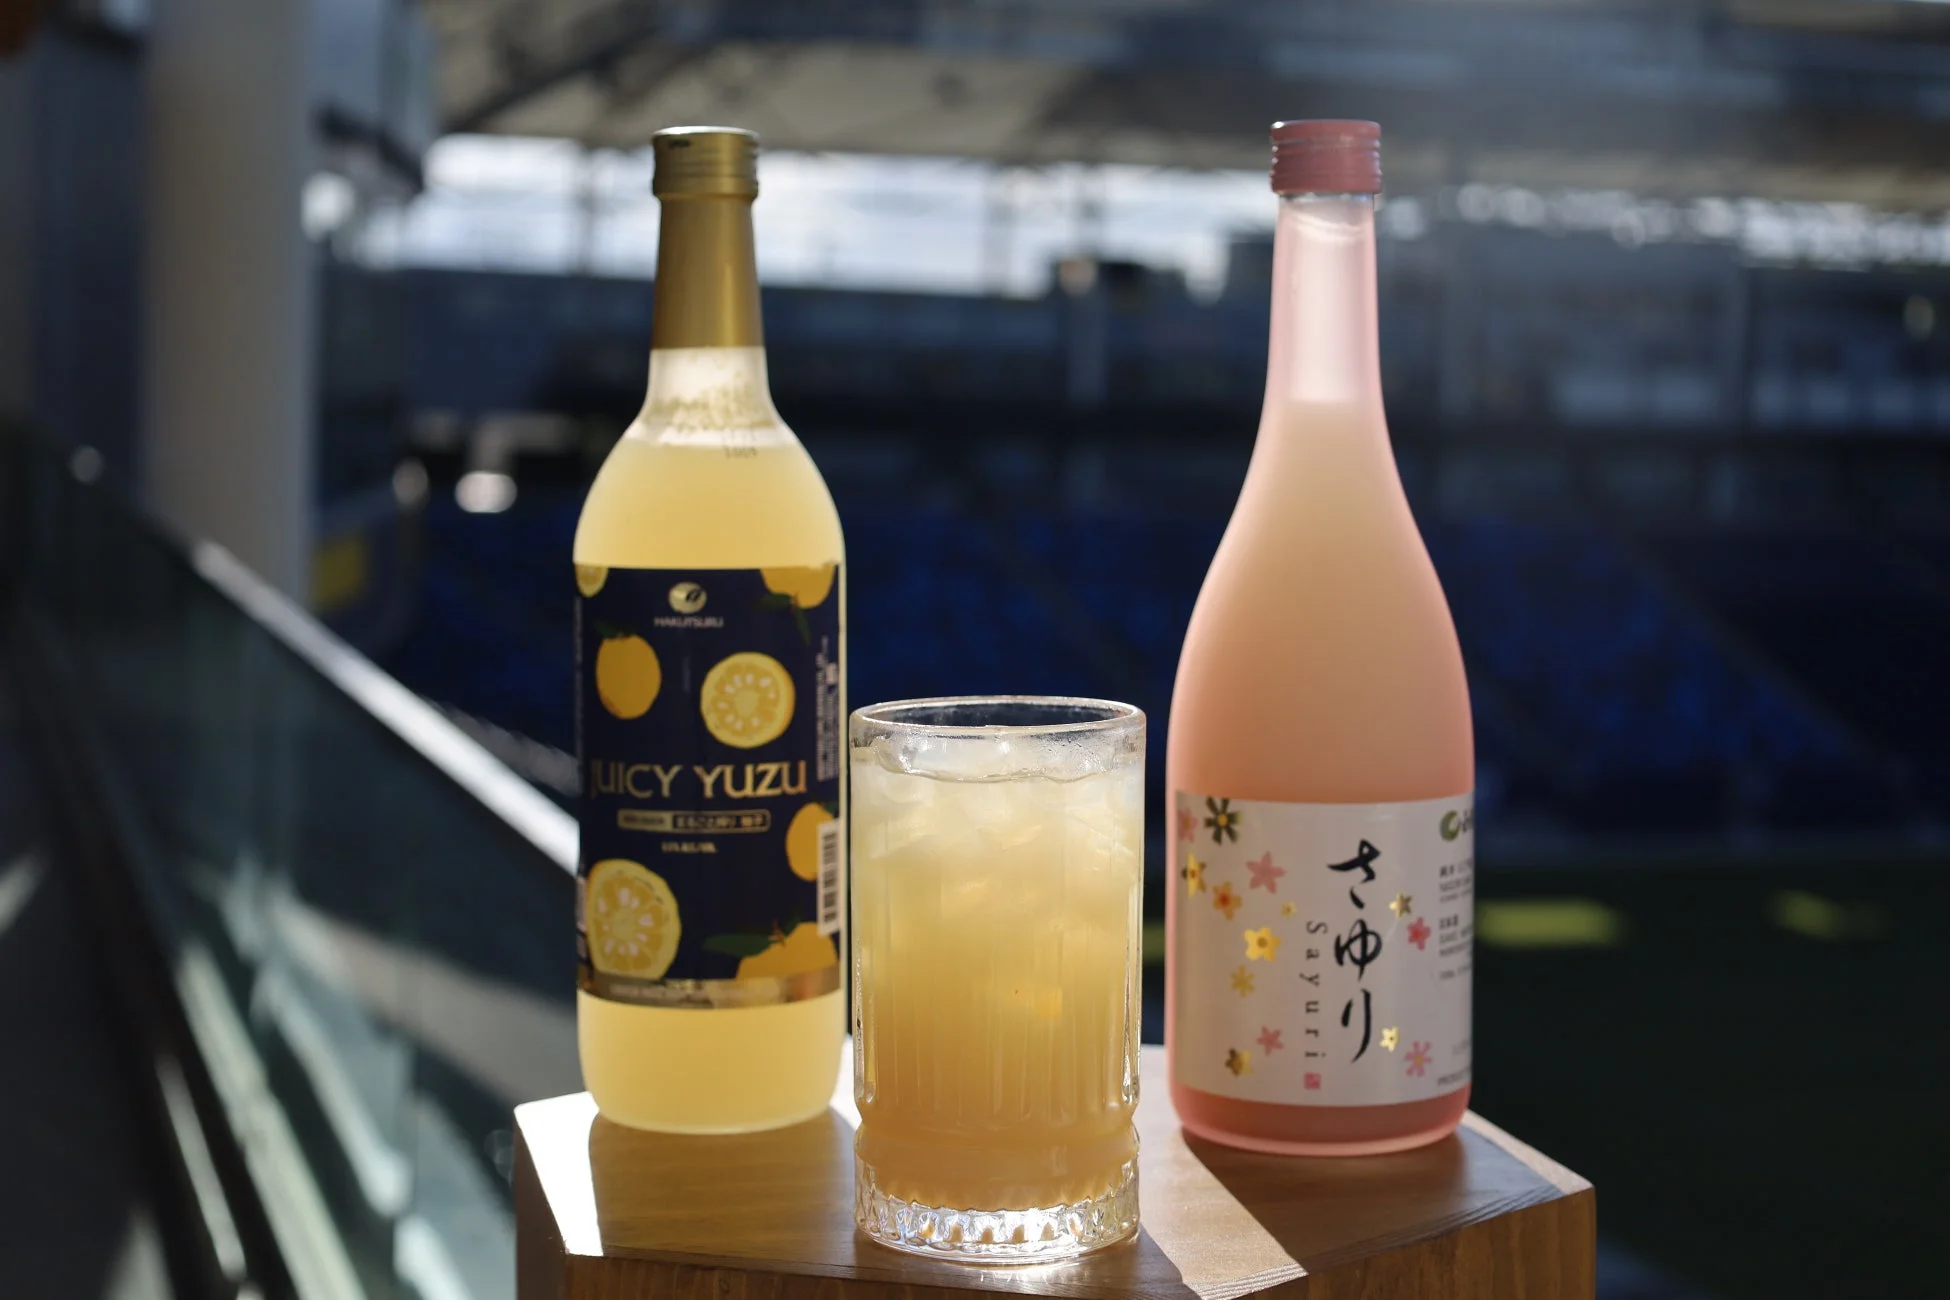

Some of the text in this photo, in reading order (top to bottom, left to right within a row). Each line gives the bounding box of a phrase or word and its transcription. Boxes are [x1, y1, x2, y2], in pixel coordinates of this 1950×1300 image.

[653, 616, 725, 628] HAKUTSURU
[591, 759, 807, 799] JUICY YUZU
[1299, 920, 1328, 1058] Sayuri
[1327, 838, 1382, 1063] さゆり
